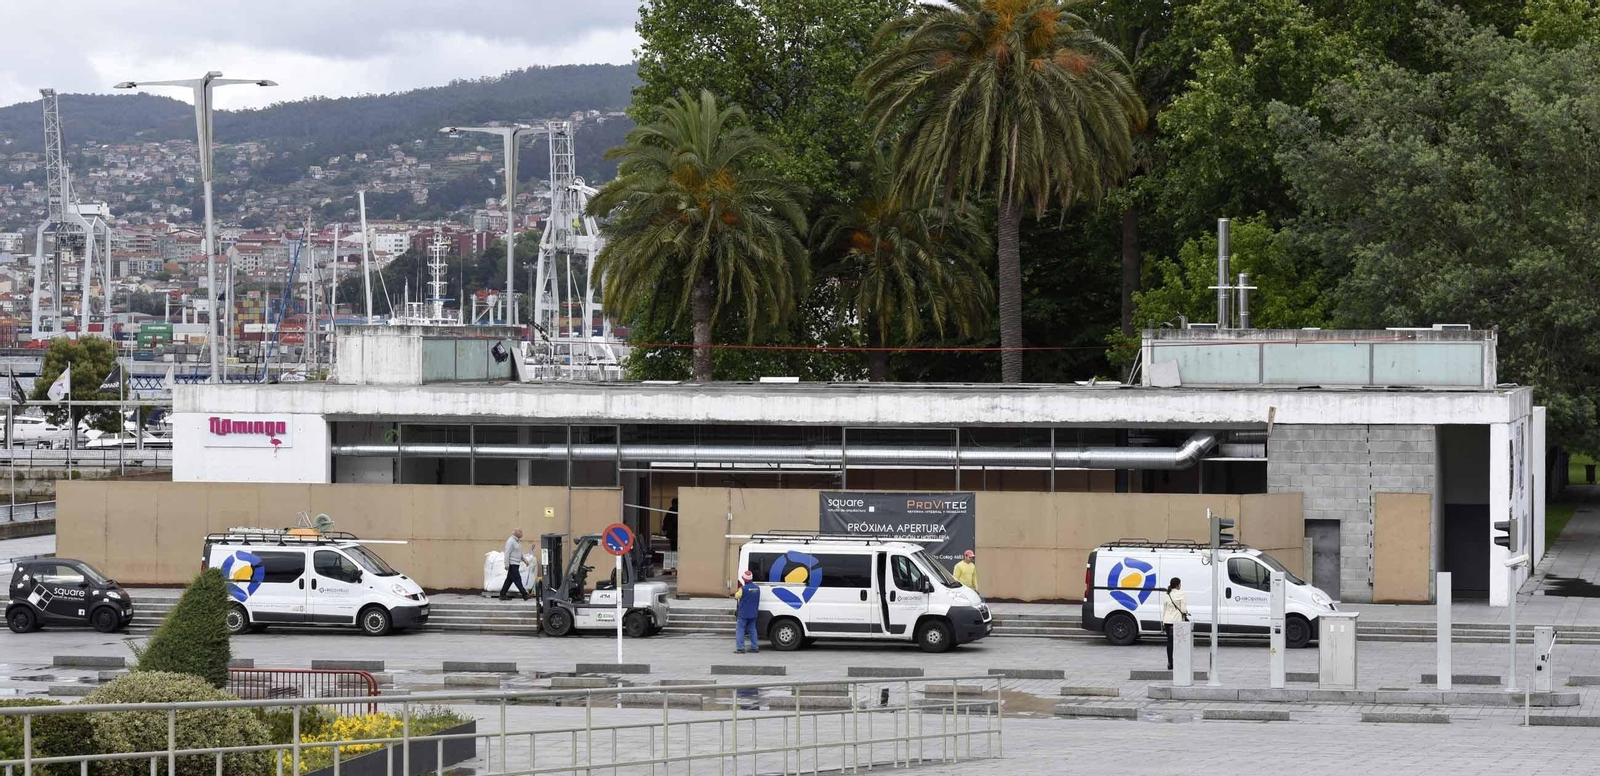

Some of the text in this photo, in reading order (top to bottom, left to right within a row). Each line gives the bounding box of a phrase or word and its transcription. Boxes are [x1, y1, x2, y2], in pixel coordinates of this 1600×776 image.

[828, 498, 864, 508] square
[847, 521, 946, 533] PRÓXIMA APERTURA
[54, 587, 85, 598] square
